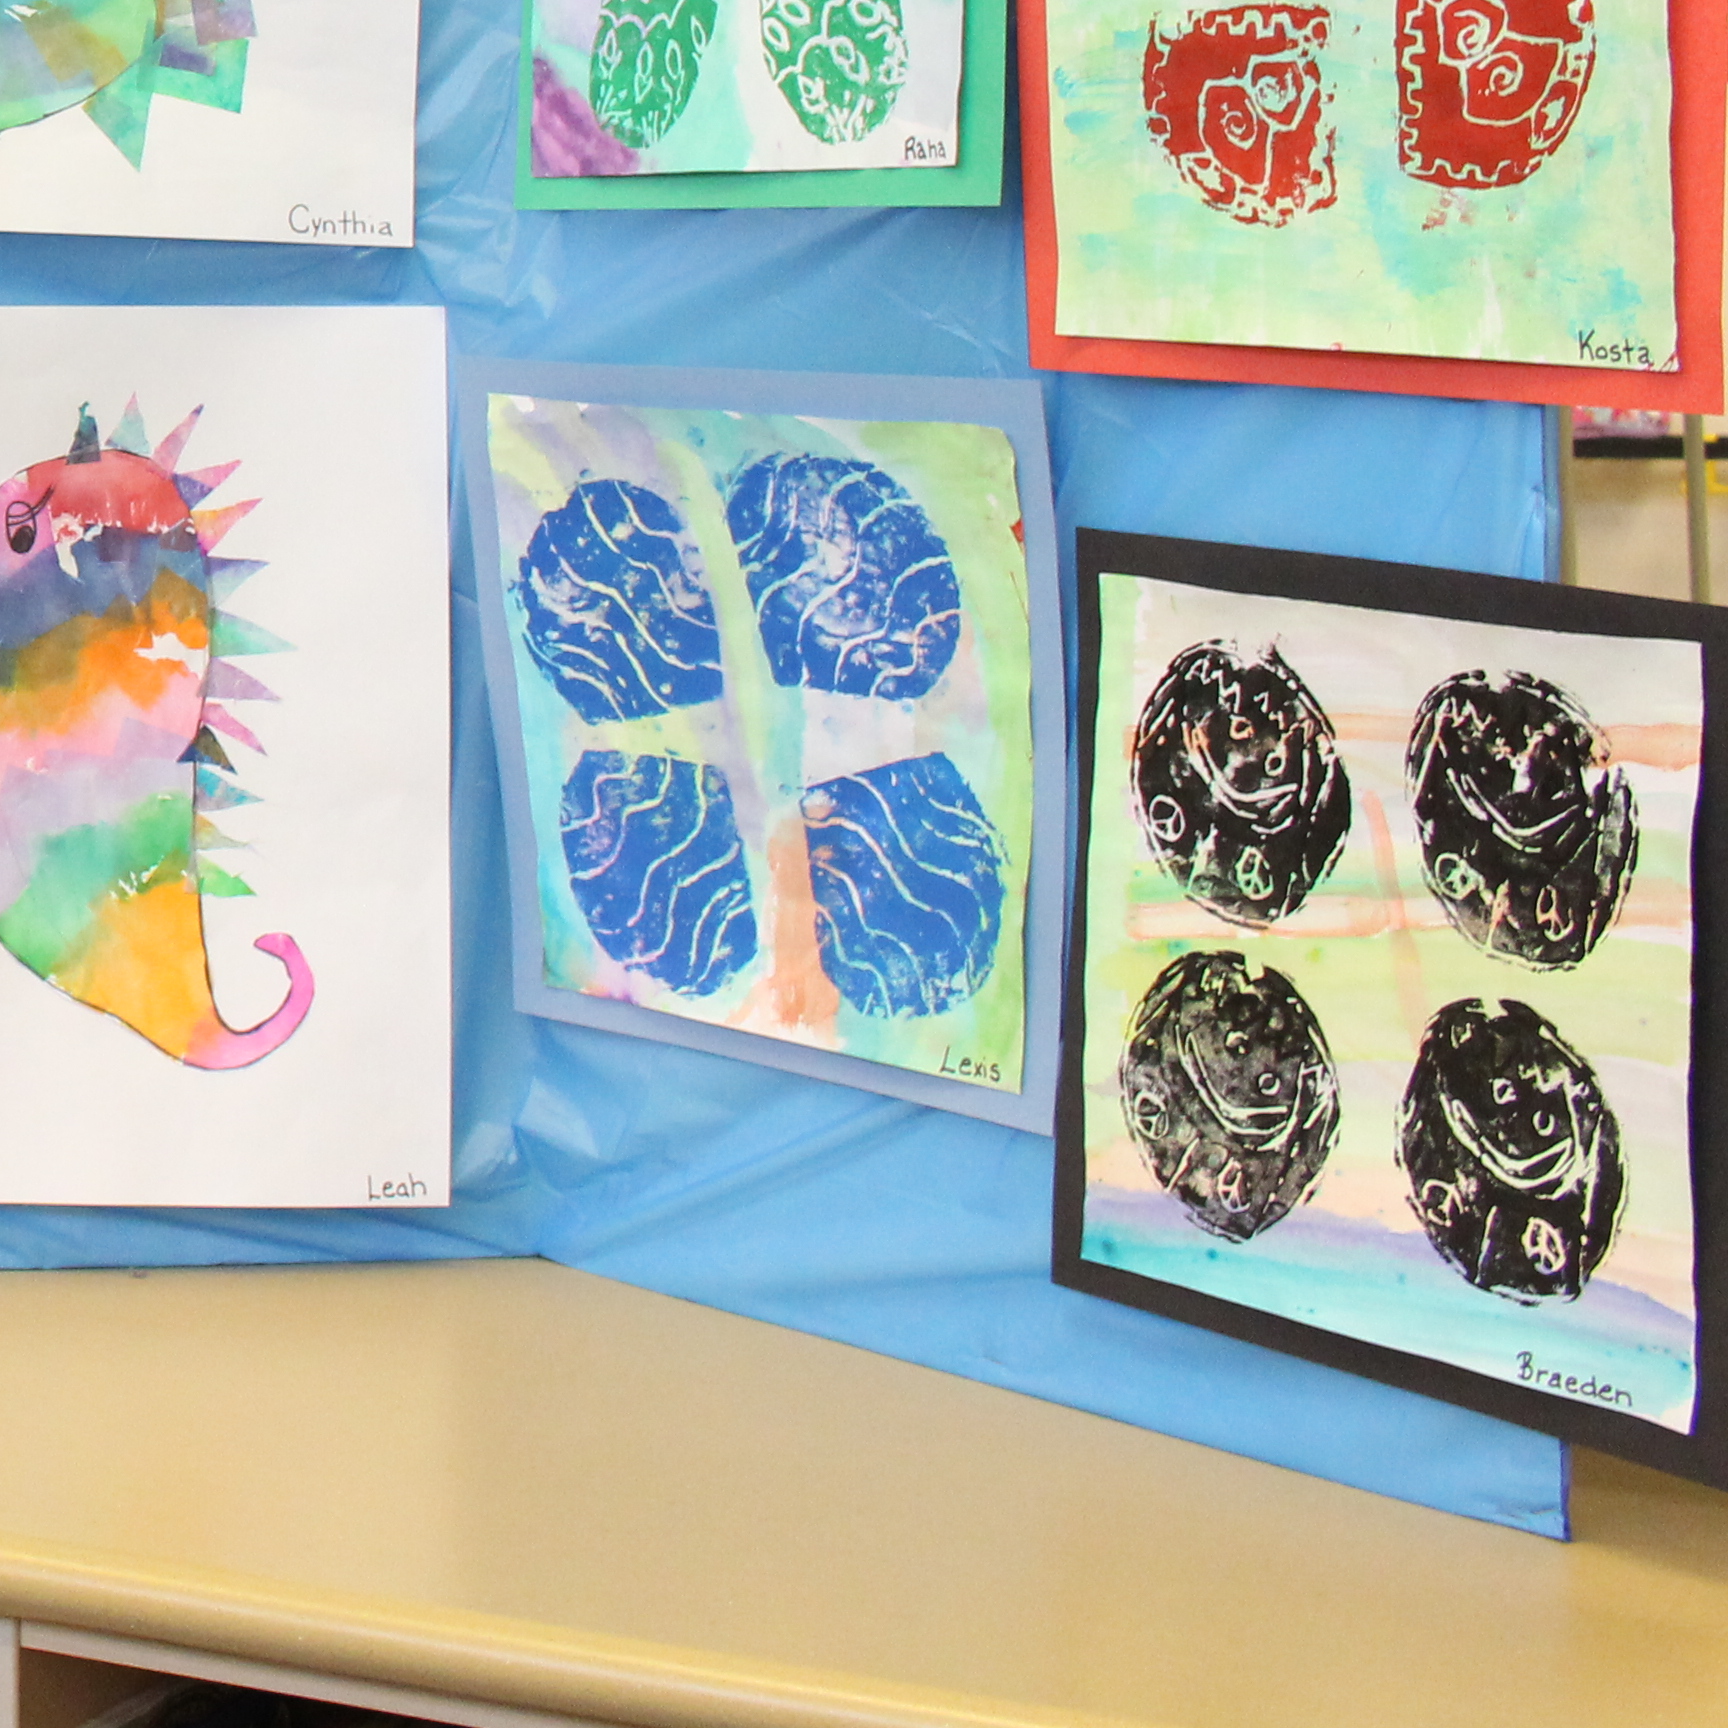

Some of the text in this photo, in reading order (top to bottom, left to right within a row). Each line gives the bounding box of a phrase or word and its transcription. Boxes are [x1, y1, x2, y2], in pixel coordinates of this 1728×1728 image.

[904, 136, 946, 161] Raha
[287, 203, 393, 238] Cynthia
[1578, 329, 1651, 365] Kosta
[938, 1045, 1001, 1083] Lexis
[366, 1173, 428, 1201] Leah
[1516, 1351, 1632, 1407] Braeden
